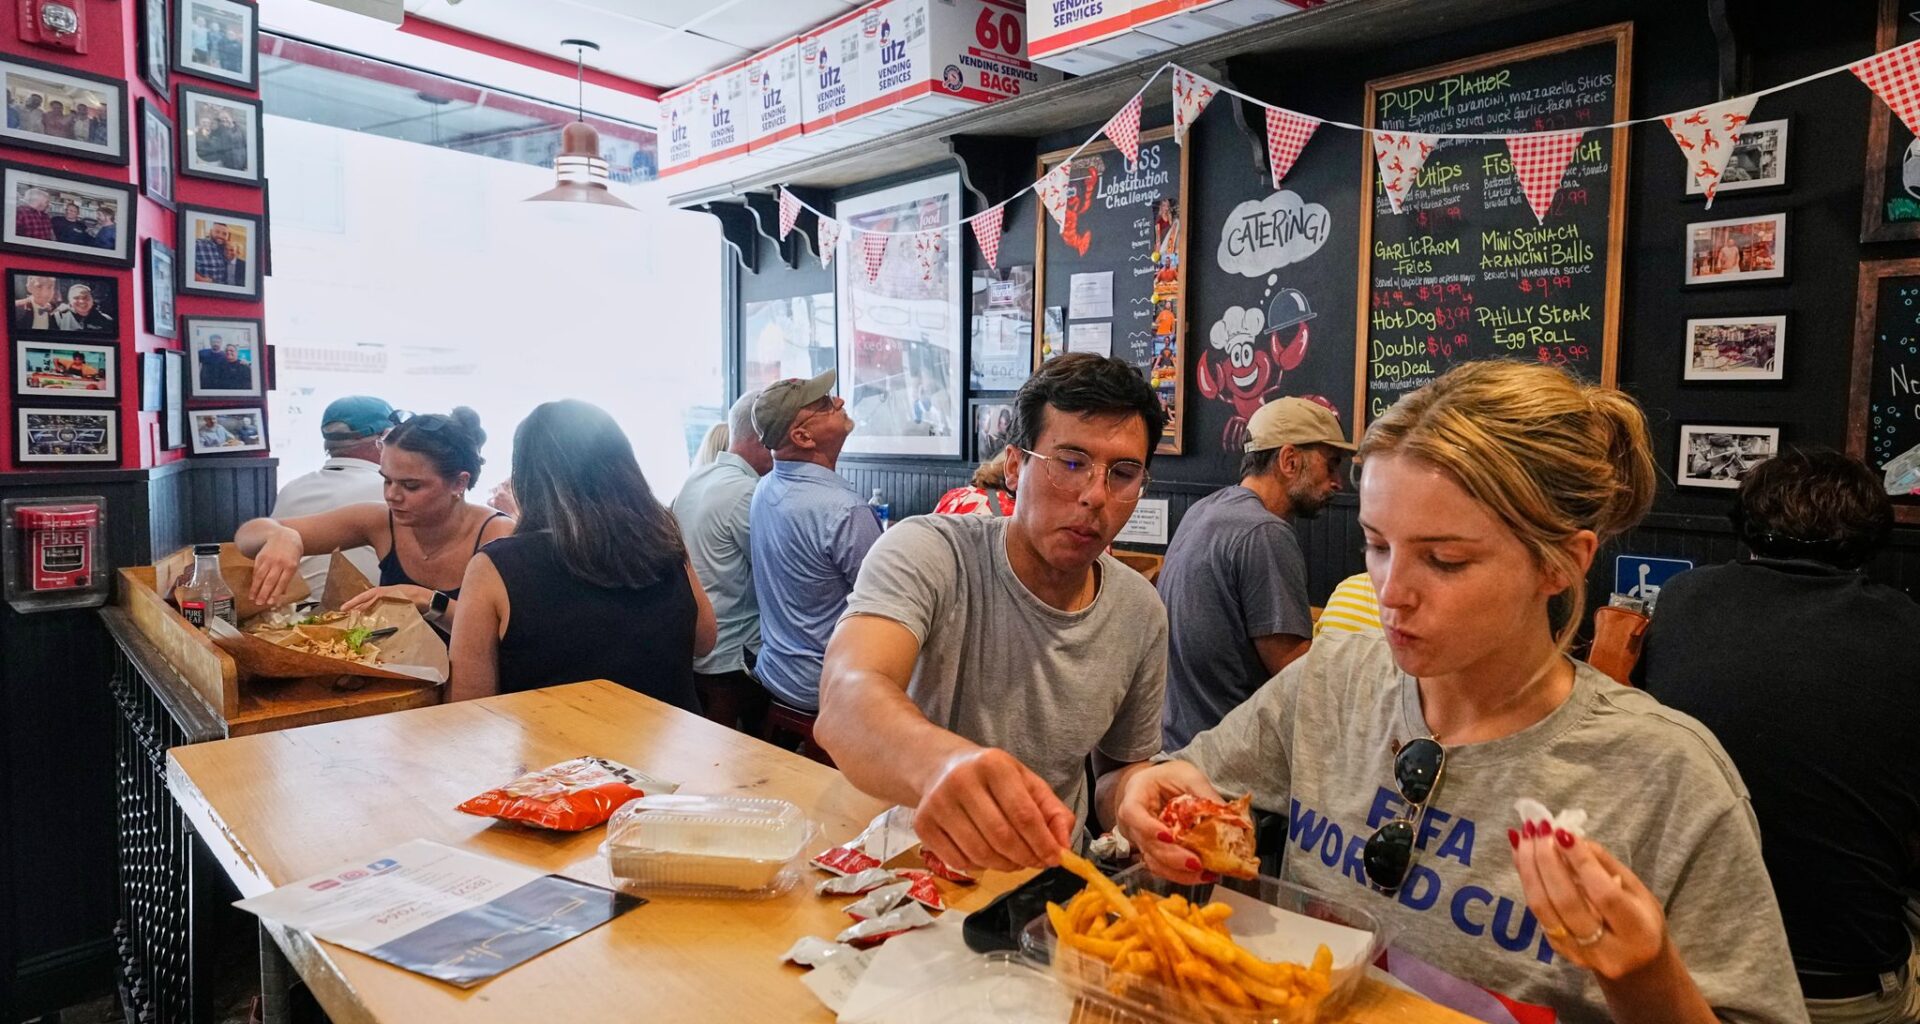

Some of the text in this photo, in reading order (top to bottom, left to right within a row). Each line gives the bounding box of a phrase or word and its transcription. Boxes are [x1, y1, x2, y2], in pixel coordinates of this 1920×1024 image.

[1053, 0, 1095, 14] VEND
[1053, 2, 1103, 28] SERVICES
[976, 6, 1021, 55] 60
[878, 59, 911, 79] VENDING
[959, 54, 999, 73] VENDING
[1001, 65, 1038, 82] SERVICES
[879, 70, 911, 91] SERVICES
[980, 71, 1020, 95] BAGS
[817, 84, 845, 103] VENDING
[818, 95, 845, 113] SERVICES
[761, 105, 786, 122] VENDING
[762, 115, 786, 131] SERVICES
[710, 125, 735, 139] VENDING
[1096, 170, 1169, 199] Lobstitution
[1105, 188, 1161, 209] Challenge
[1372, 309, 1404, 331] Hot
[1405, 308, 1437, 332] Dog
[1370, 335, 1427, 363] Double
[1493, 328, 1525, 350] Egg
[1374, 362, 1400, 383] Dog
[41, 532, 85, 545] FIRE
[1366, 786, 1476, 867] FFA
[1289, 798, 1442, 911] WORD
